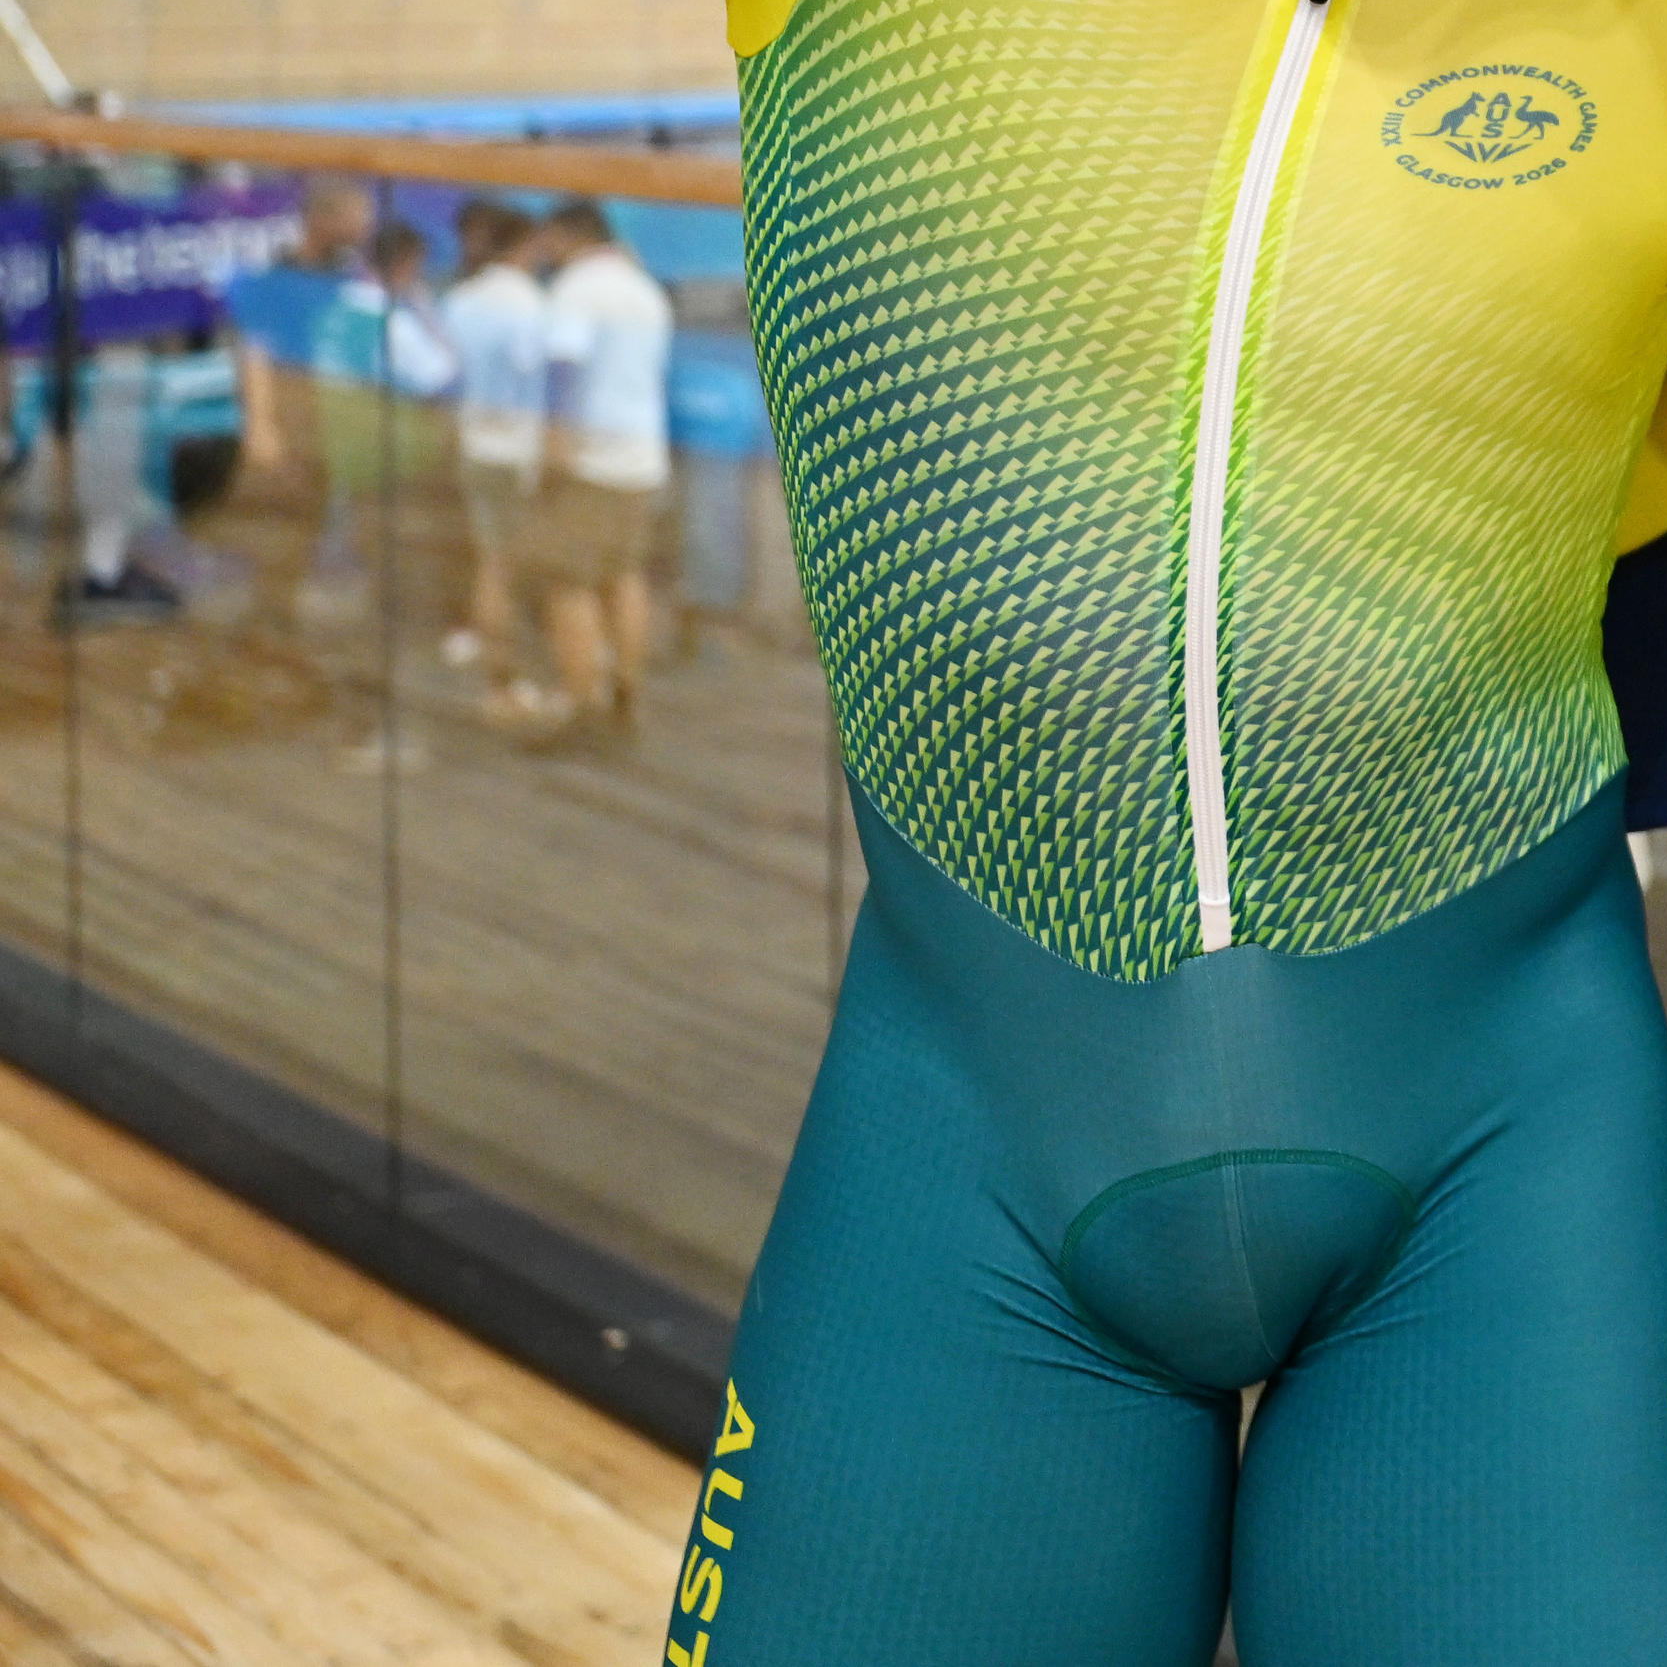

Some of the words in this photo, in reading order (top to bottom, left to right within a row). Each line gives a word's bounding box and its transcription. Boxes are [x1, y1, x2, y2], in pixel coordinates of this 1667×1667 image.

[1395, 64, 1588, 108] COMMONWEALTH
[1569, 101, 1598, 152] GAMES
[1396, 154, 1504, 190] GLASGOW
[1512, 158, 1567, 186] 2026
